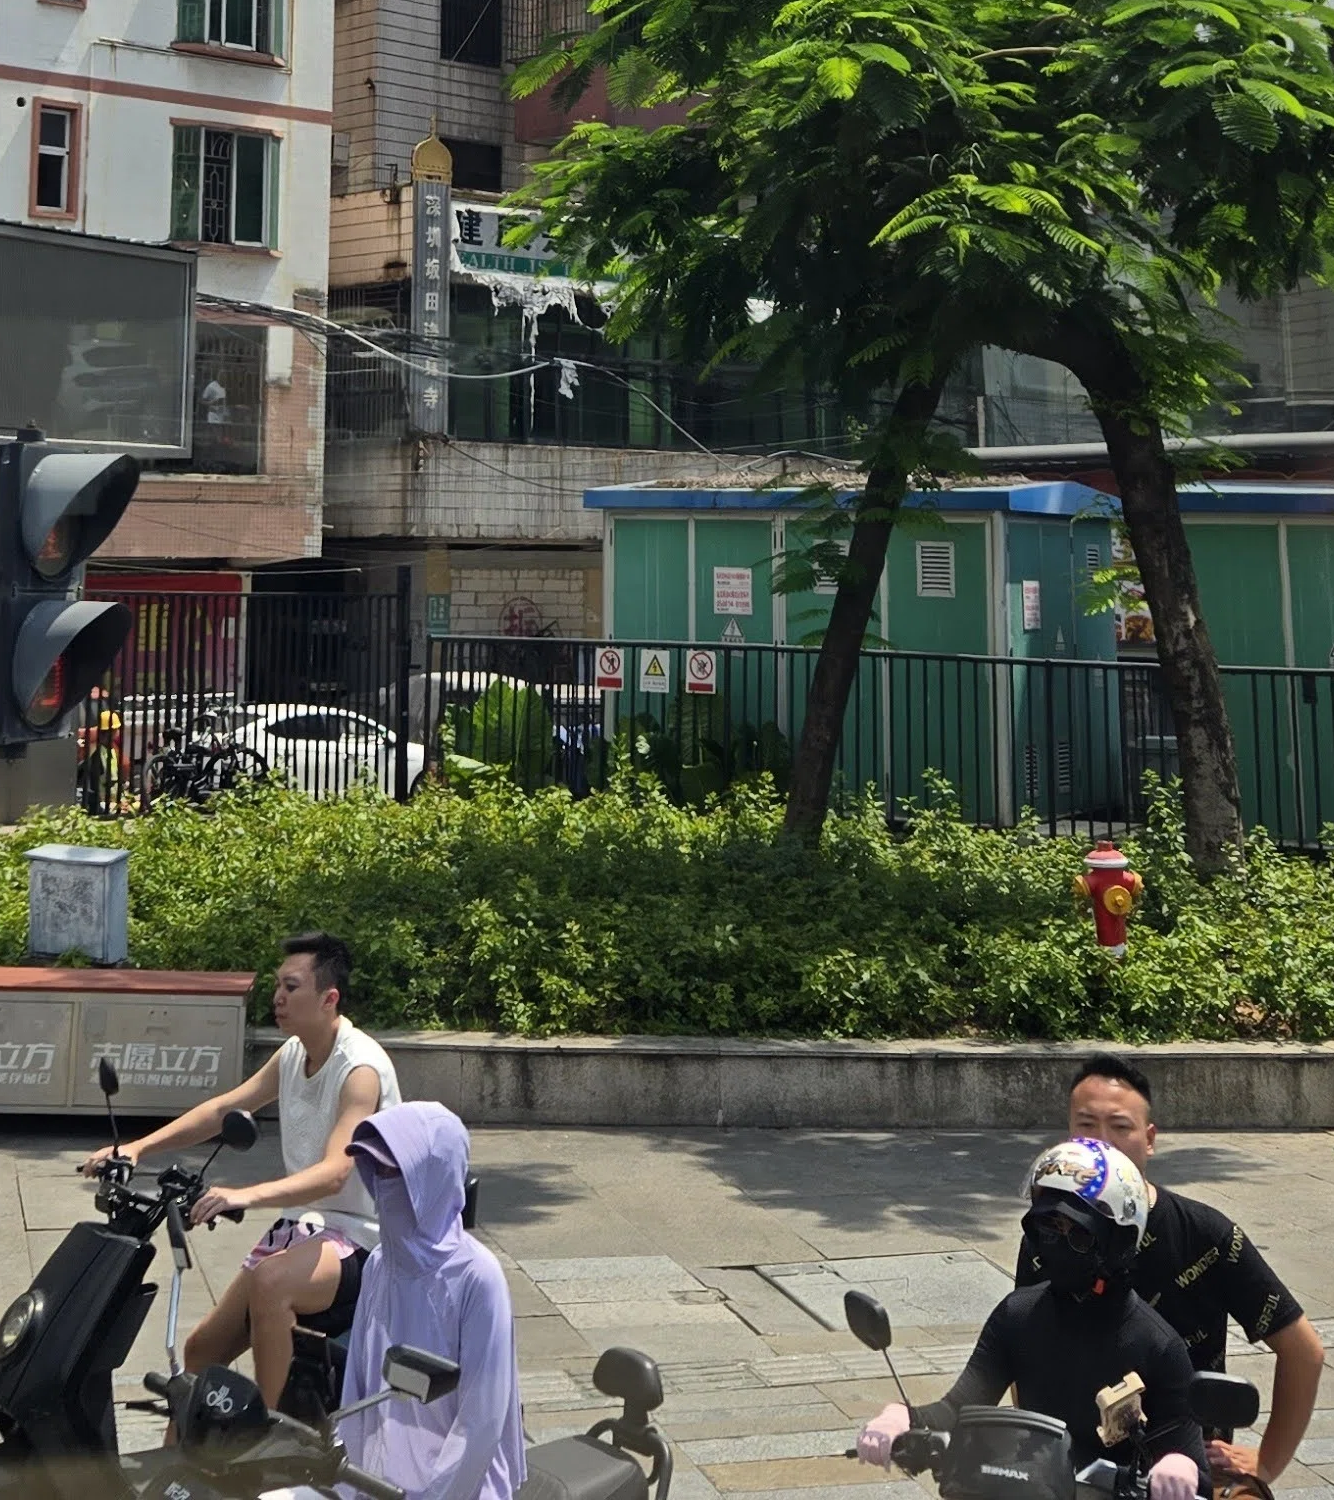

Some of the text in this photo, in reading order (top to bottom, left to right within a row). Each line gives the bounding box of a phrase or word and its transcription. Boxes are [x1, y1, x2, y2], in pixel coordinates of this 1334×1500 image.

[89, 1042, 224, 1073] 志愿立方
[1174, 1247, 1221, 1289] WONDER
